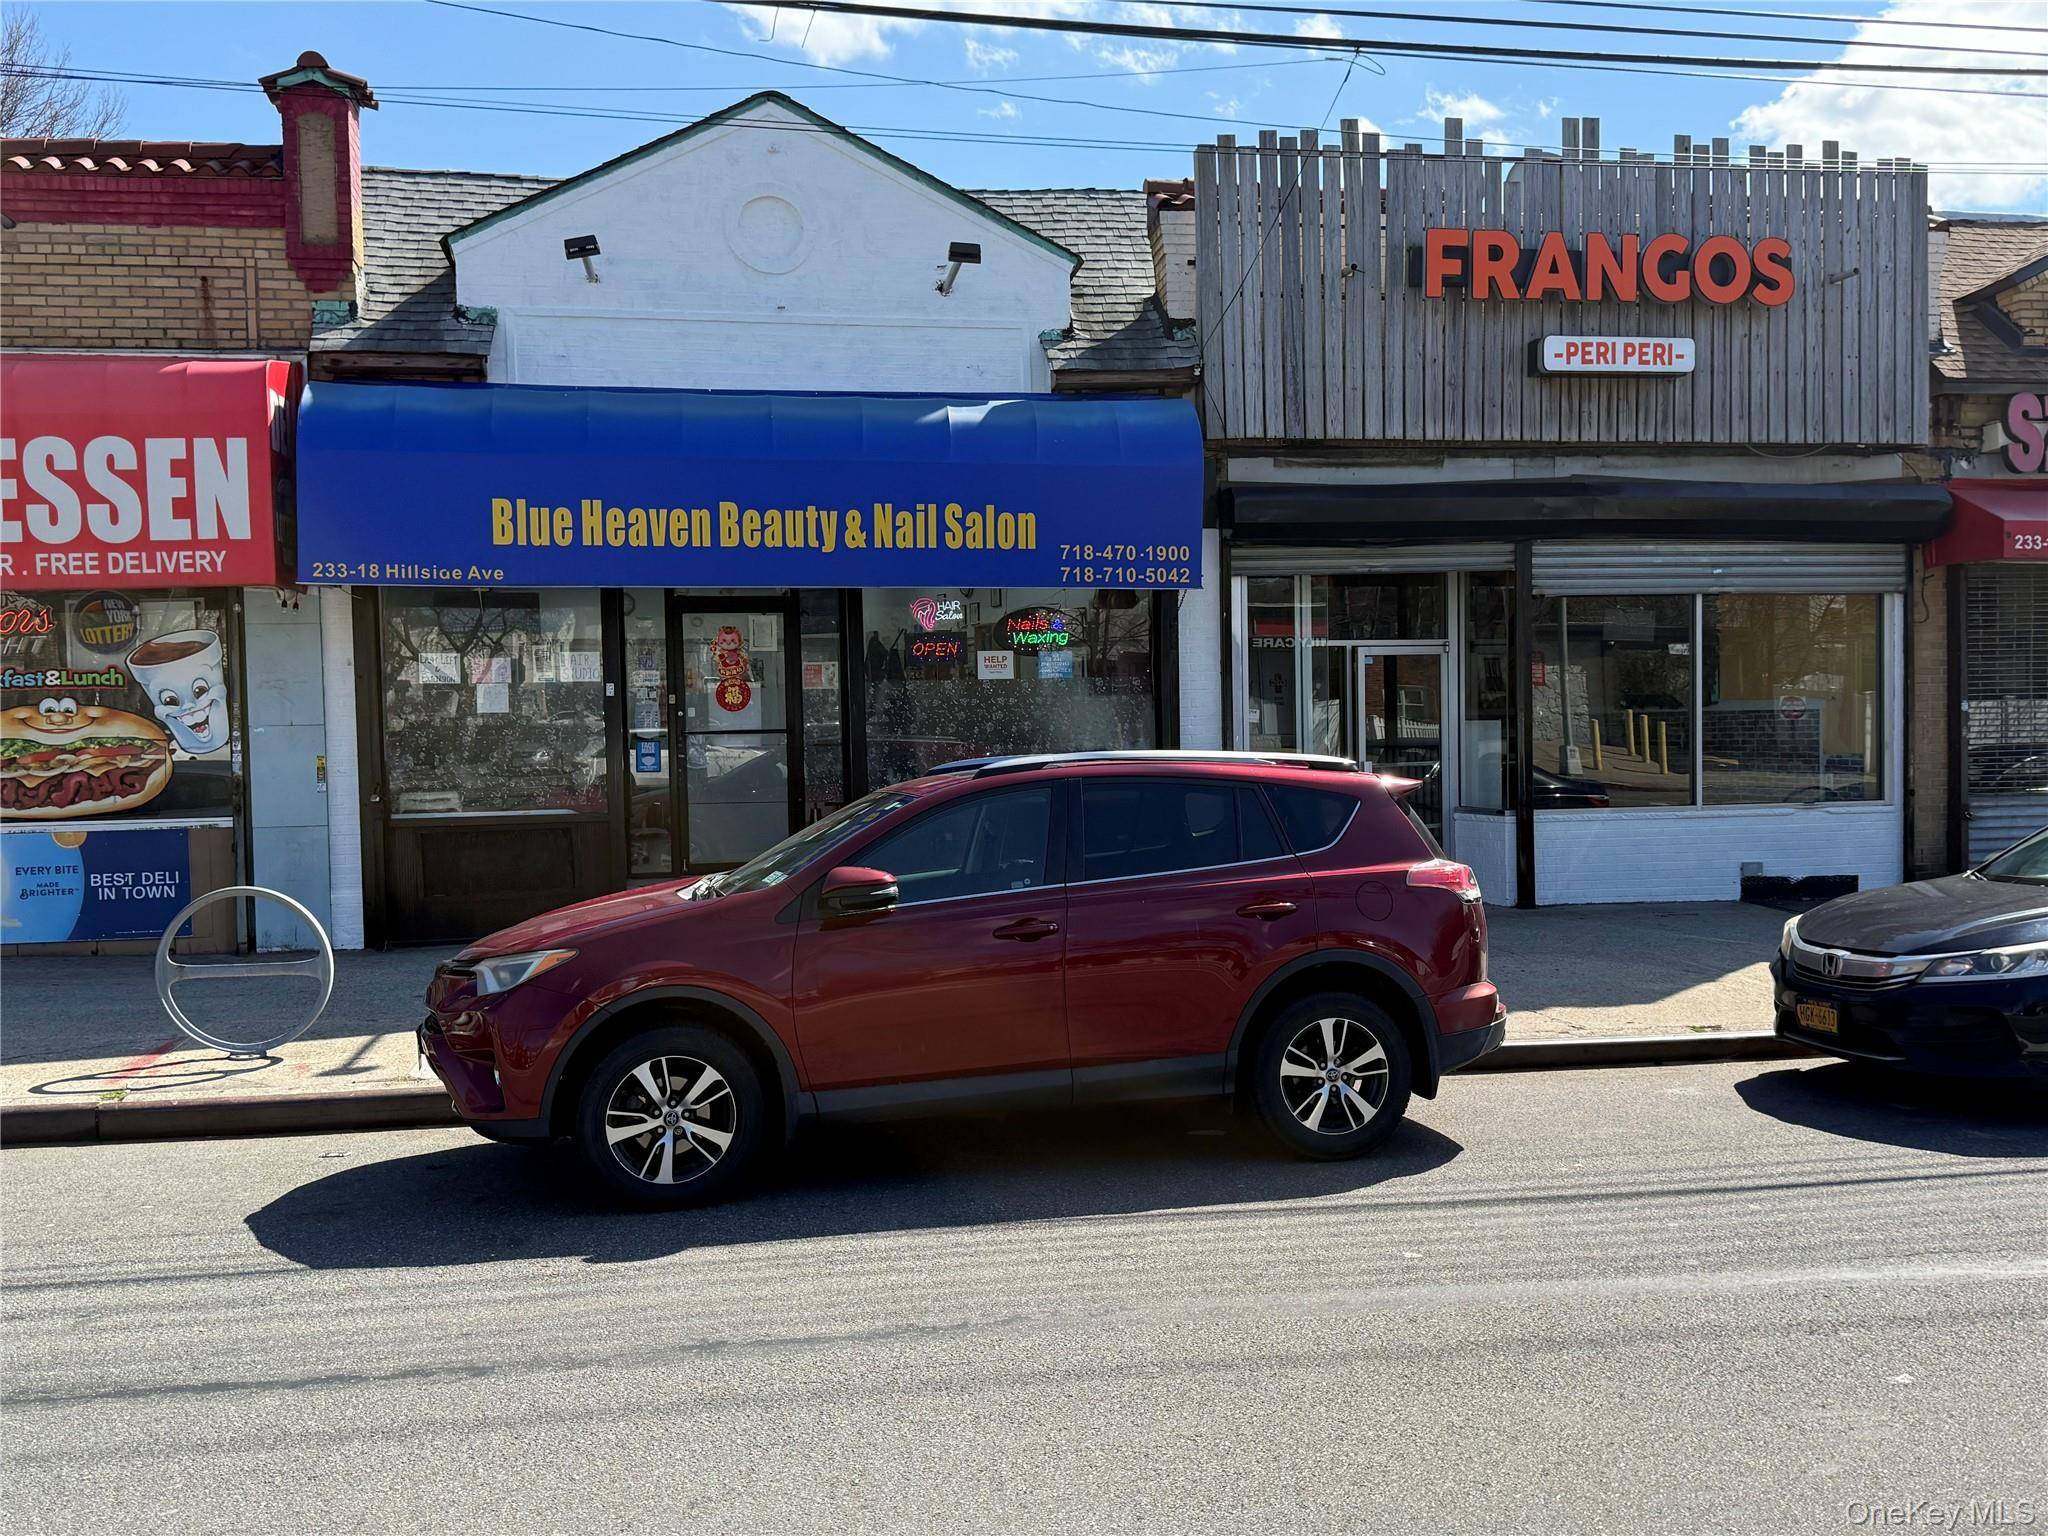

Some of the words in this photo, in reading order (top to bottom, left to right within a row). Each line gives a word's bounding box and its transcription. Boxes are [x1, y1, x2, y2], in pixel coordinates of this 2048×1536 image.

[1425, 228, 1796, 307] FRANGOS
[2006, 391, 2048, 473] S
[491, 498, 573, 546] Blue
[581, 500, 711, 547] Heaven
[719, 501, 838, 553] Beauty
[844, 509, 867, 548] &
[873, 503, 937, 548] Nail
[944, 503, 1036, 549] Salon
[2014, 534, 2048, 550] 233-
[35, 553, 100, 576] FREE
[107, 550, 227, 575] DELIVERY
[312, 562, 380, 579] 233-18
[467, 565, 504, 581] Ave
[1060, 566, 1190, 583] 718-710-5042
[103, 599, 126, 610] NEW
[937, 600, 961, 611] HAIR
[107, 608, 133, 623] YORK
[934, 610, 963, 621] Salon
[1007, 618, 1049, 631] Nails
[79, 622, 135, 645] LOTTERY
[1012, 630, 1069, 646] Waxing
[912, 641, 959, 657] OPEN
[984, 655, 1008, 664] HELP
[15, 866, 52, 876] EVERY
[55, 865, 79, 875] BITE
[90, 873, 135, 887] BEST
[142, 871, 179, 885] DELI
[98, 887, 116, 901] IN
[122, 885, 176, 900] TOWN
